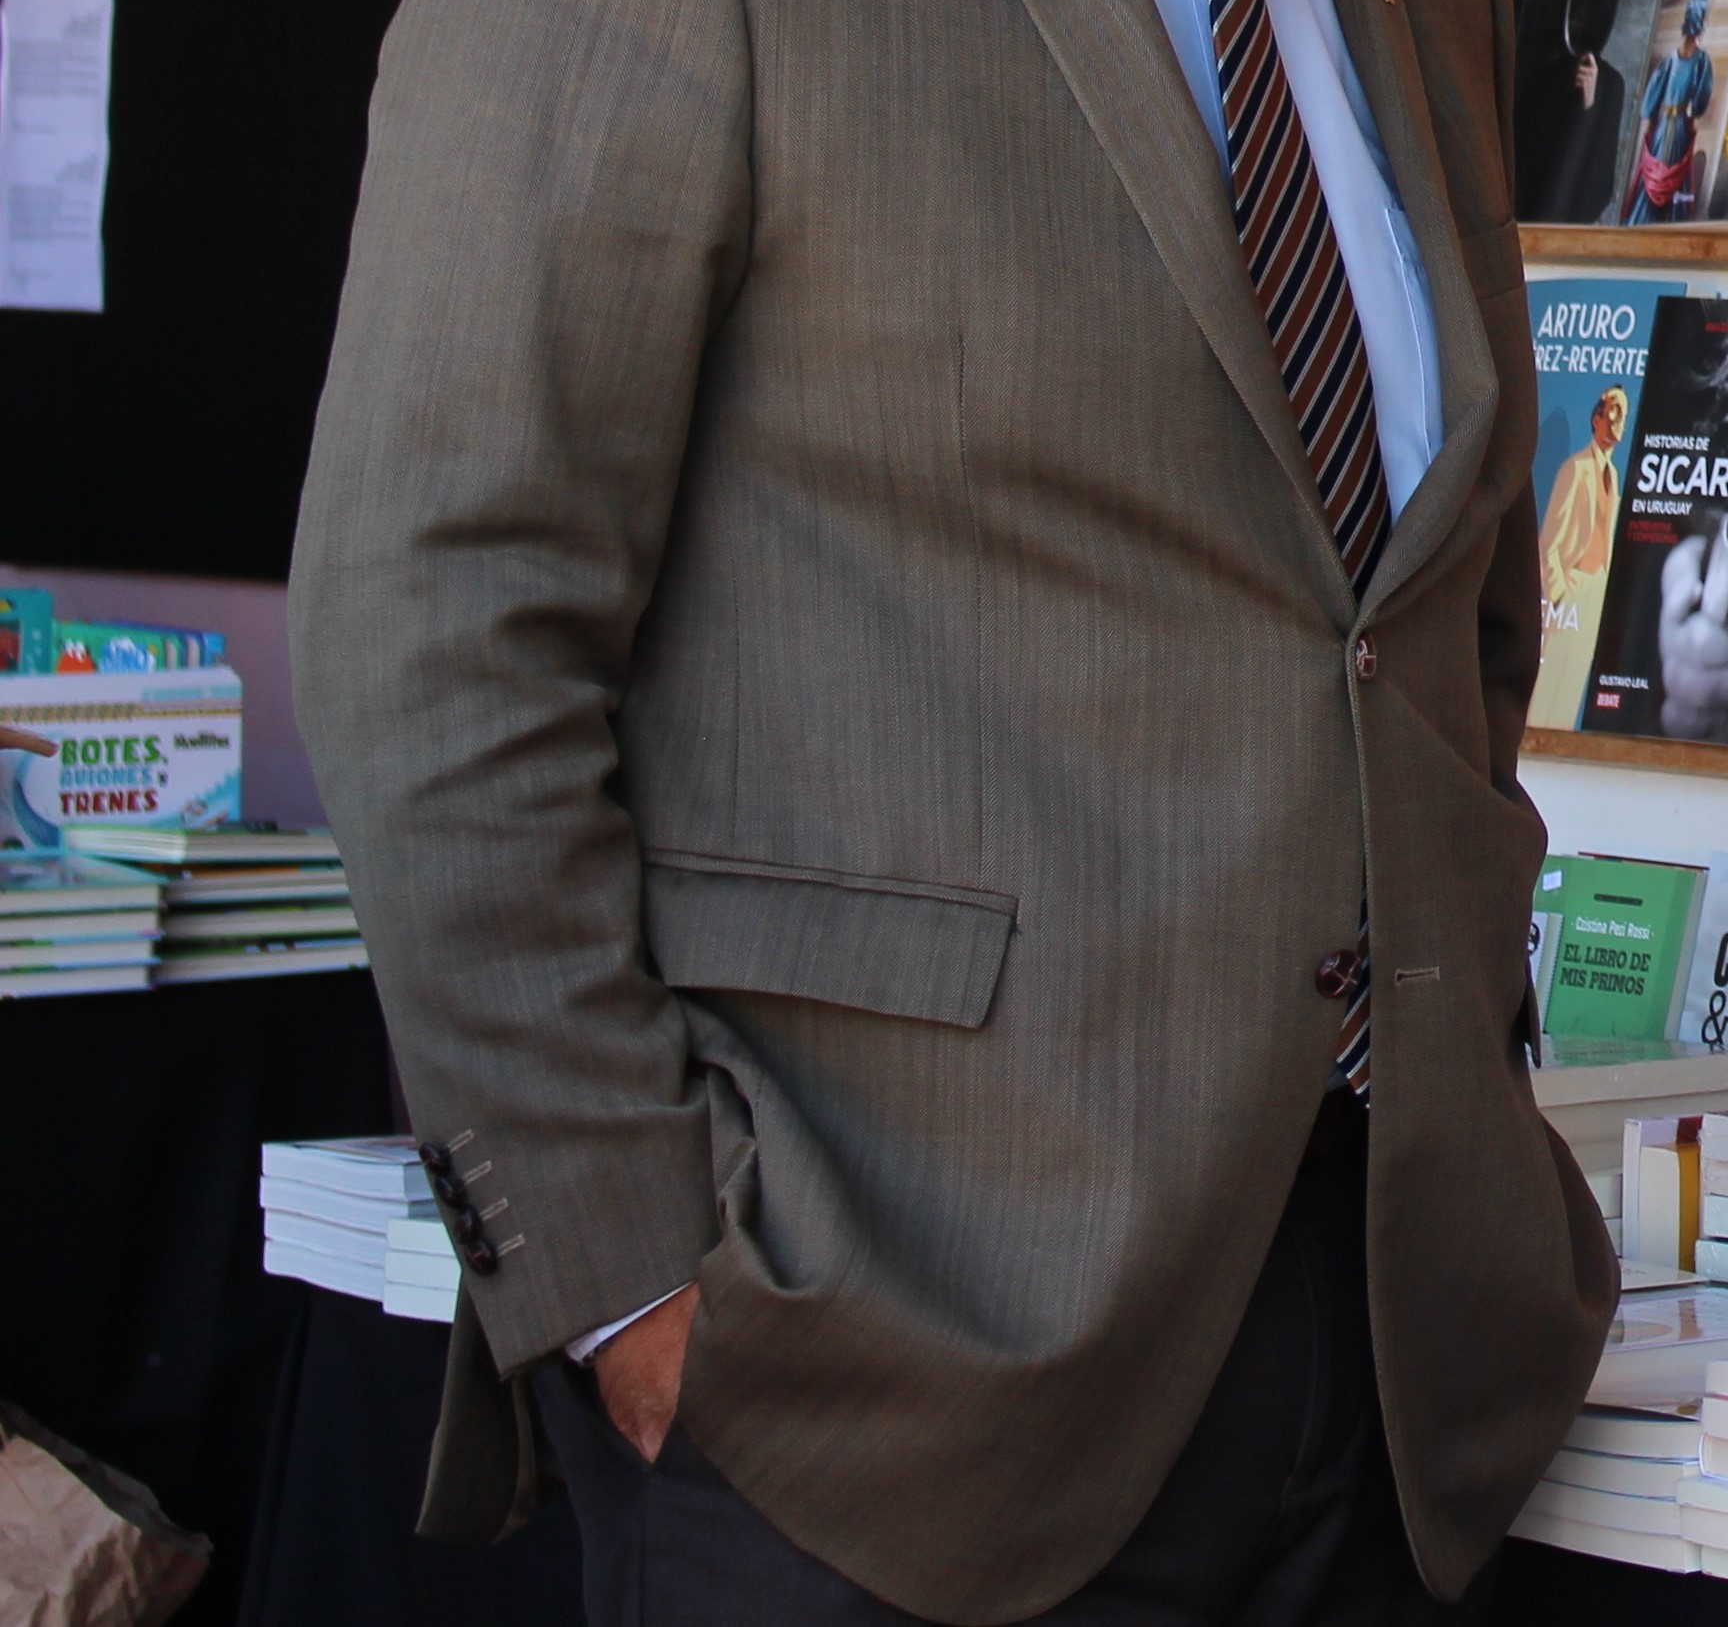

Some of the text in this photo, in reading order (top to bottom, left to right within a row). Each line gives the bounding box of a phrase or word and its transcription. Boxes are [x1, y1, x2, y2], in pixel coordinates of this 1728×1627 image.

[1537, 303, 1636, 341] ARTURO
[1532, 339, 1649, 376] REZ-REVERTE
[1644, 434, 1710, 450] HISTORIAS DE
[1632, 498, 1692, 515] EN URUGUAY
[60, 789, 157, 815] TRENES
[1564, 943, 1651, 972] EL LIBRO DE
[1560, 967, 1645, 996] MIS PRIMOS
